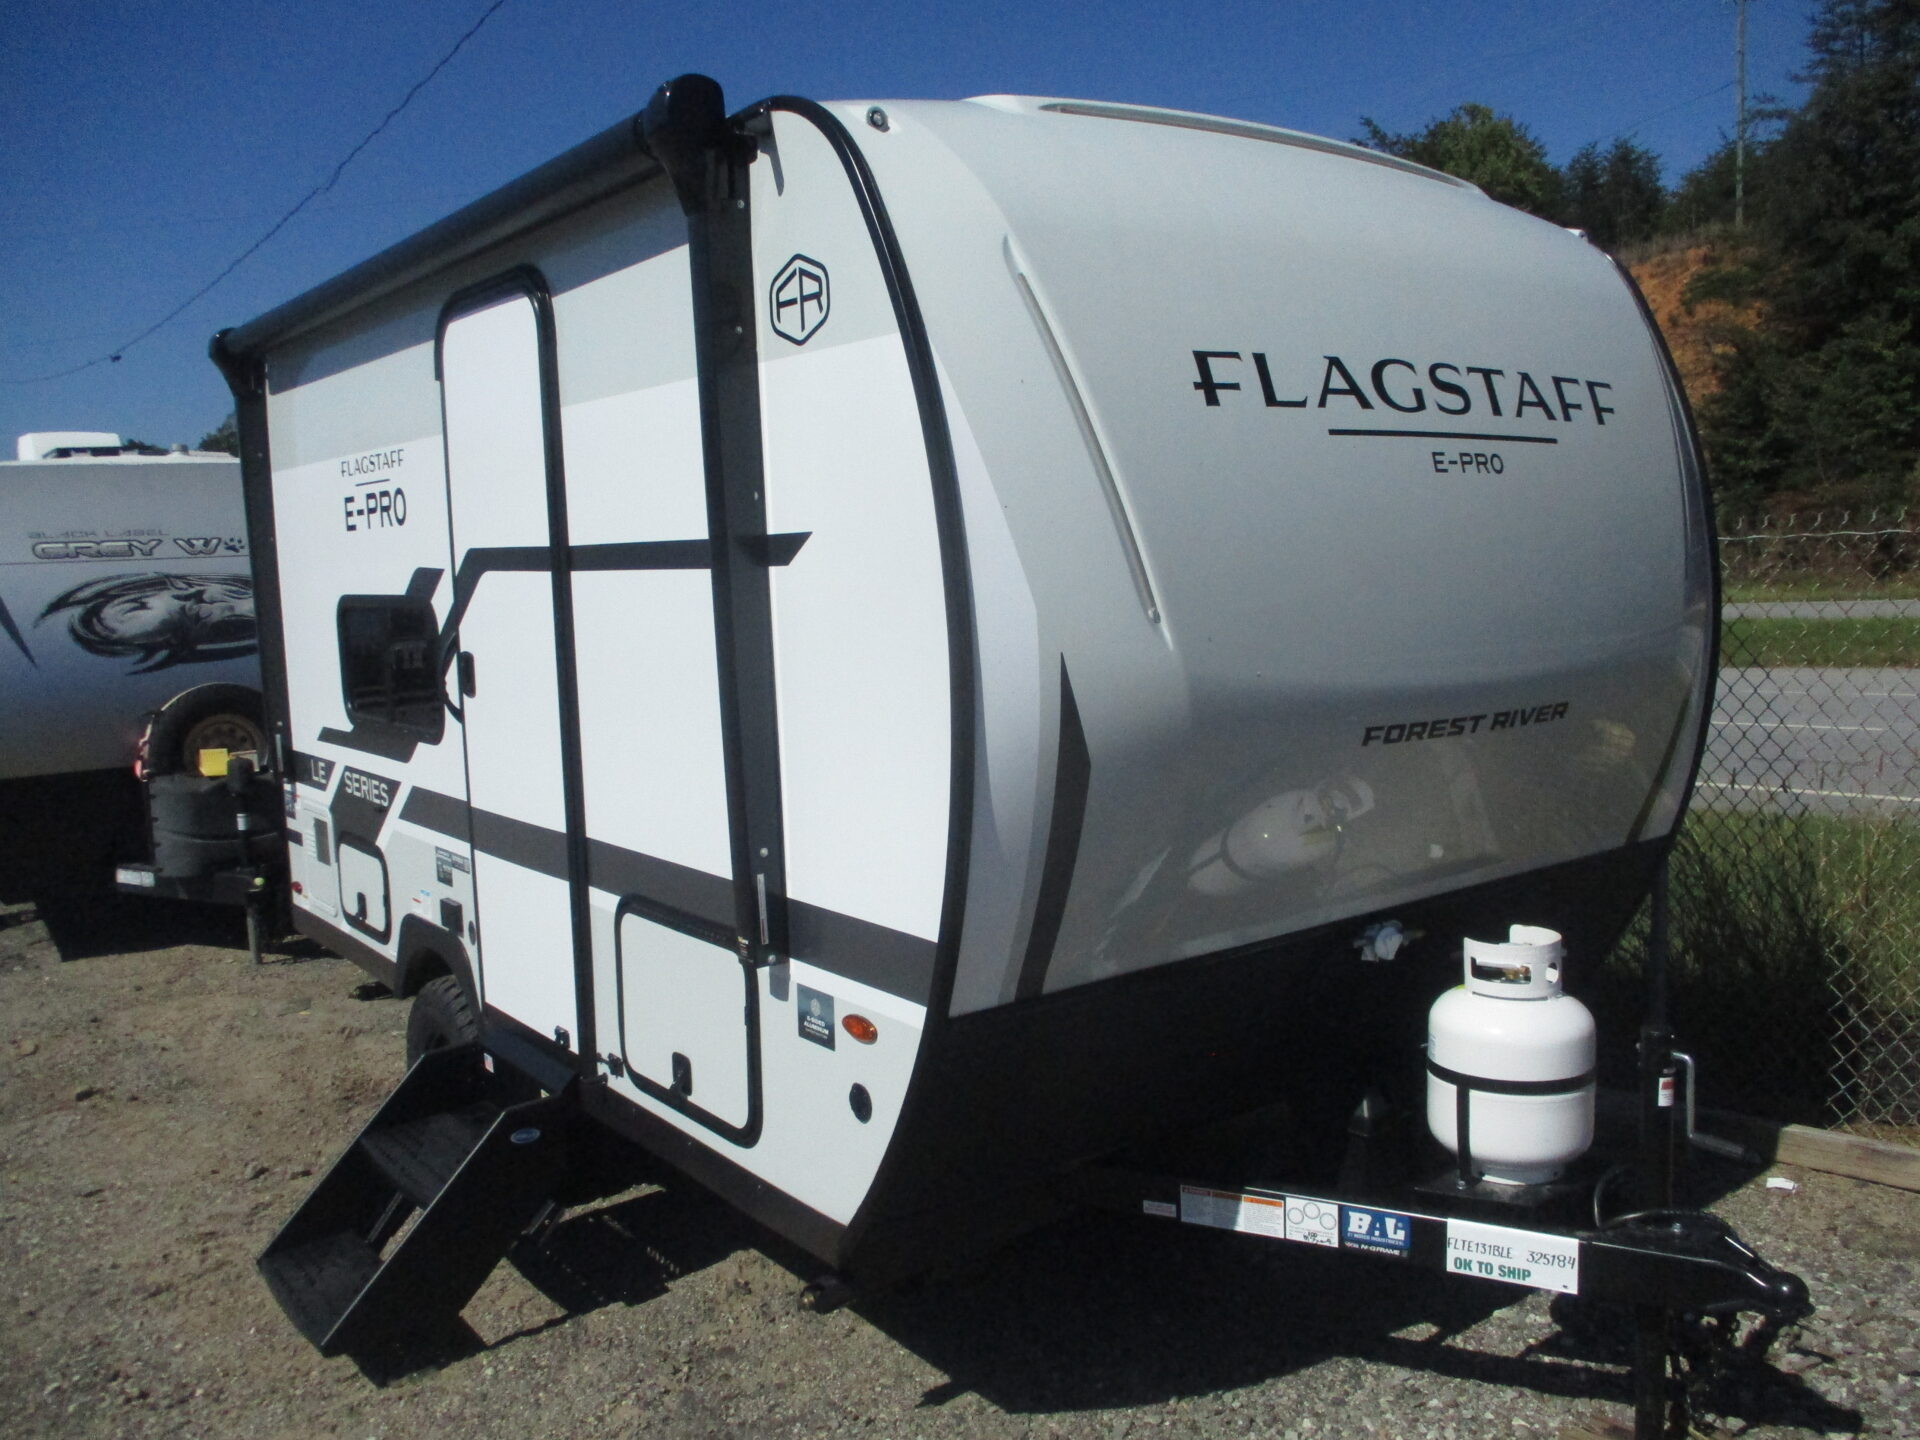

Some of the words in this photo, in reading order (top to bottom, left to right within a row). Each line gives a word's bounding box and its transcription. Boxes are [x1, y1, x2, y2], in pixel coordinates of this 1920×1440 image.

[1191, 349, 1616, 426] FLAGSTAFF
[340, 448, 404, 477] FLAGSTAFF
[1431, 451, 1505, 475] E-PRO
[344, 487, 407, 532] E-PRO
[32, 538, 162, 560] GREY
[1361, 714, 1488, 747] FOREST
[1490, 701, 1570, 731] RIVER
[310, 759, 328, 785] LE
[343, 770, 390, 808] SERIES
[1447, 1236, 1513, 1260] FLTE131BLE
[1454, 1256, 1473, 1272] OK
[1476, 1260, 1494, 1275] TO
[1498, 1264, 1532, 1281] SHIP
